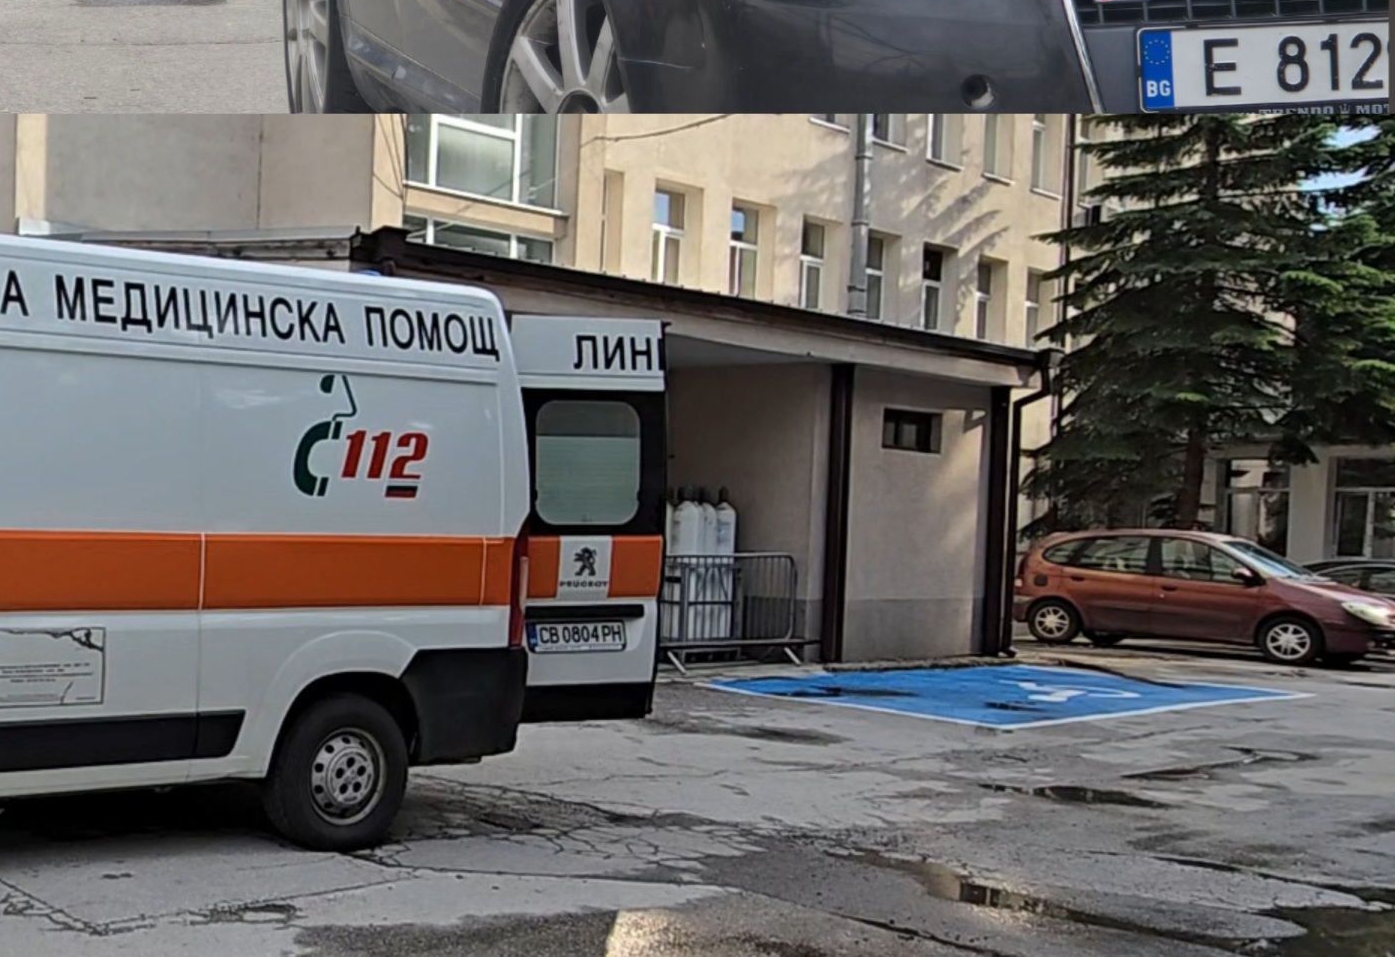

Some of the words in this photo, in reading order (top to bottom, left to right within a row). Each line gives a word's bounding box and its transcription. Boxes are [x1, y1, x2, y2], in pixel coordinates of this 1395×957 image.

[1146, 80, 1172, 98] BG
[1203, 38, 1242, 96] E
[1277, 32, 1389, 92] 812
[54, 274, 346, 345] МЕДИЦИНСКА
[364, 305, 501, 363] ПОМОЩ
[341, 430, 429, 480] 112
[539, 626, 560, 644] CB
[562, 625, 600, 643] 0804
[601, 624, 622, 642] PH
